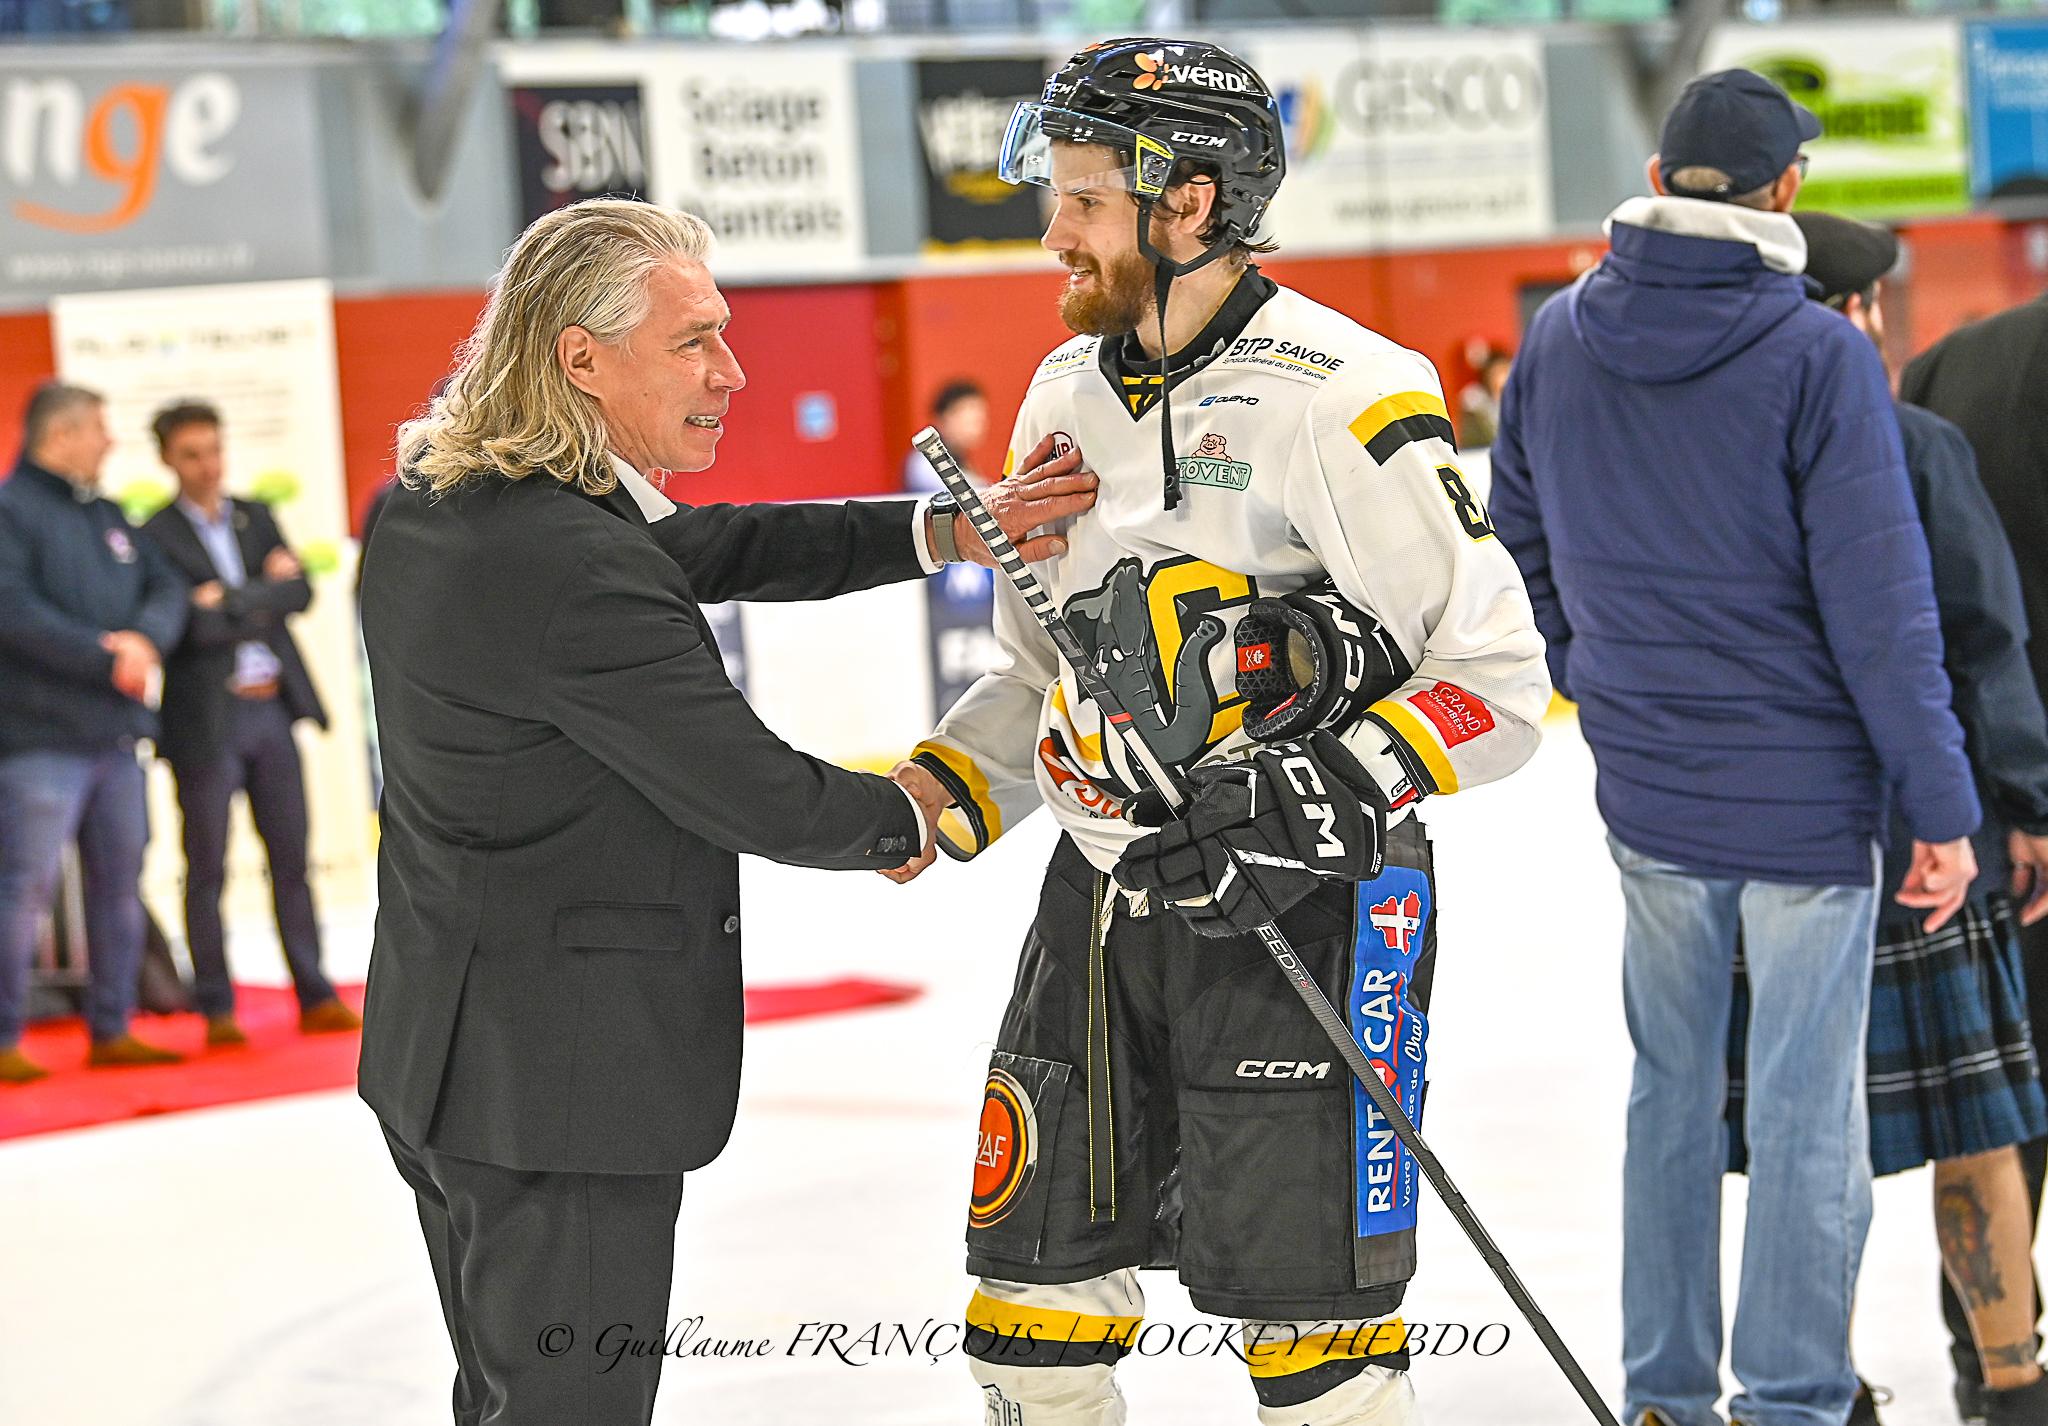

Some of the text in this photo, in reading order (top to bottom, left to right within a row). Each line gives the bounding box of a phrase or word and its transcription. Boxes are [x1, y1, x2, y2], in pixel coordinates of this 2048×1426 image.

[6, 71, 240, 236] nge
[1170, 130, 1229, 148] CCM
[1229, 338, 1344, 371] BTP SAVOIE
[1285, 363, 1303, 373] BTP
[1176, 461, 1247, 486] ROVENT
[1434, 464, 1496, 541] 8
[1440, 687, 1481, 731] GRAND
[1257, 924, 1297, 970] EED
[1361, 969, 1398, 1053] CAR
[1235, 1060, 1331, 1080] CCM
[1402, 1160, 1411, 1207] Votre
[1411, 1068, 1418, 1090] de
